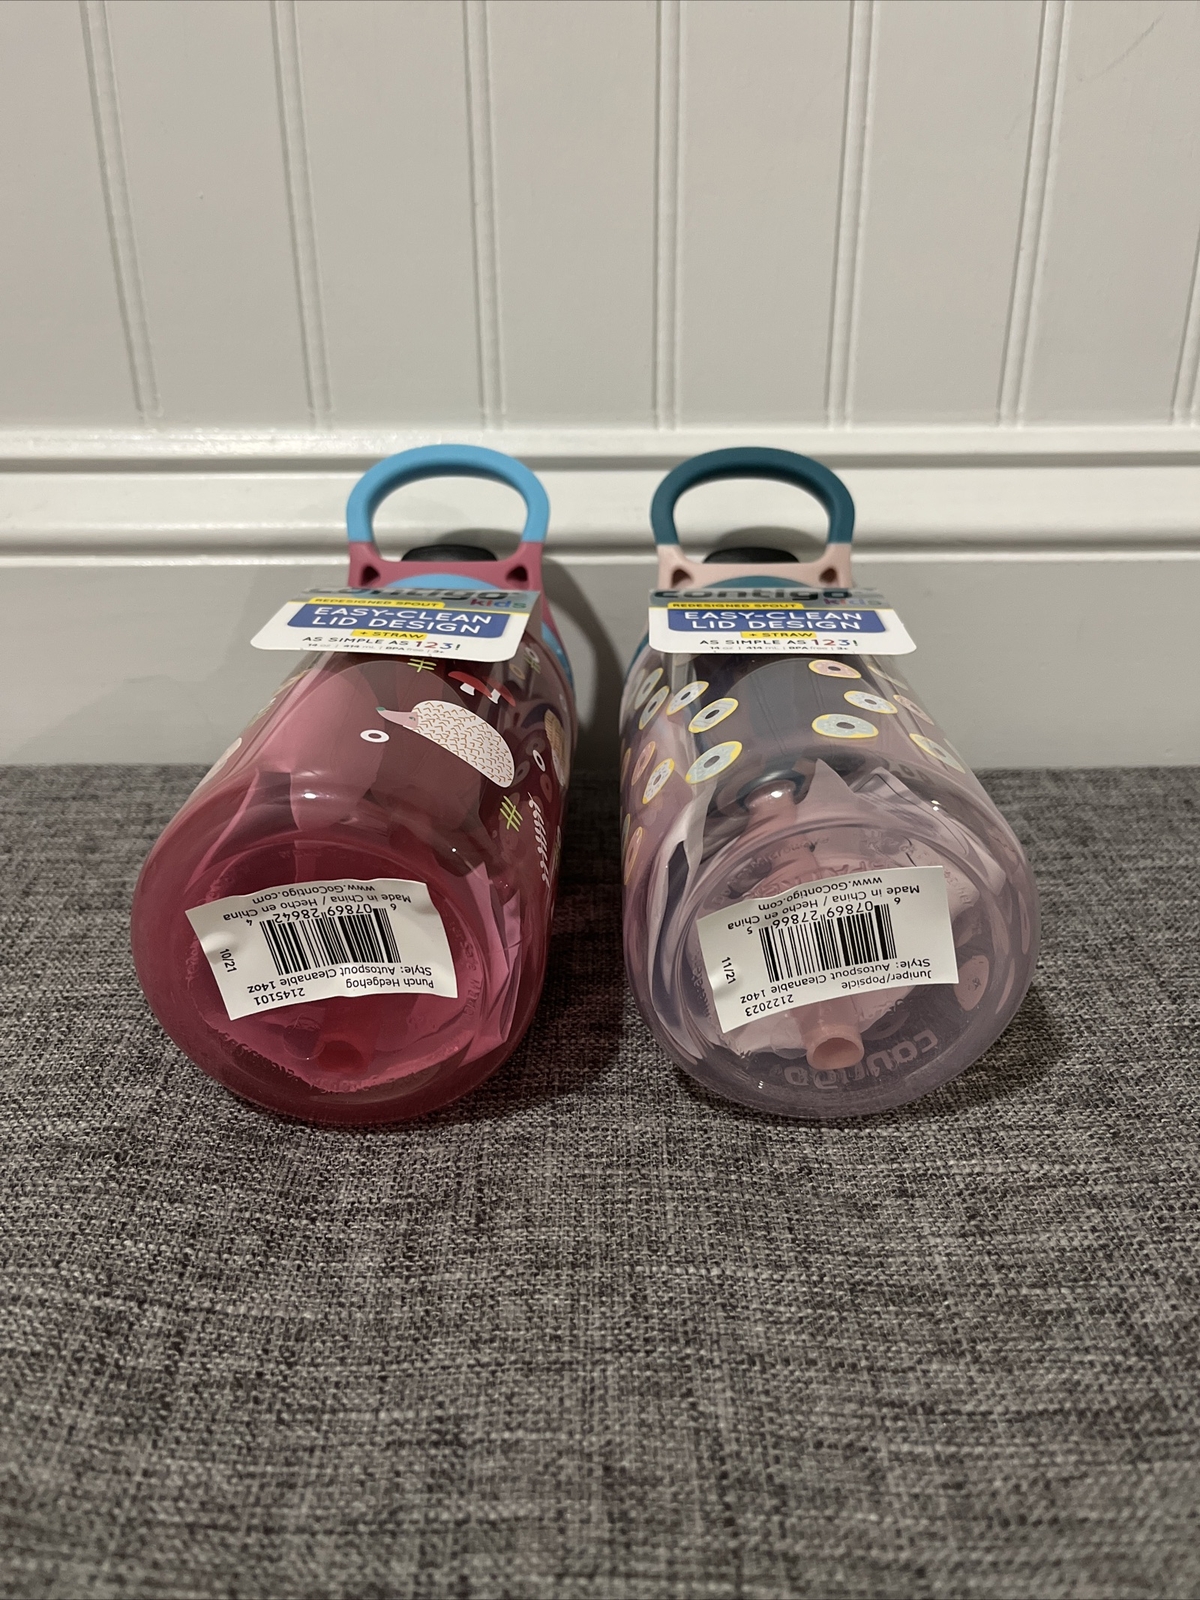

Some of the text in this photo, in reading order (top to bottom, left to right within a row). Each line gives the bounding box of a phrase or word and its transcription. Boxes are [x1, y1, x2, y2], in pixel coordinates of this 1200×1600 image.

[314, 597, 392, 605] REDESIGNED
[470, 598, 527, 609] kids
[314, 606, 492, 625] EASY-CLEAN
[684, 611, 862, 621] EASY-CLEAN
[312, 616, 481, 635] LID DESIGN
[691, 620, 861, 631] LID DESIGN
[328, 637, 384, 645] SIMPLE
[372, 630, 424, 639] STRAW
[252, 884, 376, 905] www.GoContigo.com
[757, 876, 883, 912] www.GoContigo.com
[871, 888, 883, 897] in
[886, 884, 920, 894] Made
[280, 898, 318, 909] Hecho
[331, 894, 364, 903] China
[380, 893, 412, 904] Made
[832, 891, 867, 903] China
[261, 903, 277, 913] en
[782, 899, 819, 914] Hecho
[222, 908, 259, 921] China
[245, 903, 397, 927] 6 07869 28642 4
[746, 896, 901, 935] 6 07869 27866 5
[764, 911, 779, 921] en
[727, 914, 761, 930] China
[219, 948, 238, 973] 10/21
[721, 956, 737, 985] 11/21
[246, 964, 433, 994] Style: Autospout Cleanable 14oz
[345, 977, 435, 989] Punch Hedgehog
[740, 958, 931, 1004] Style: Autospout Cleanable 14oz
[841, 969, 932, 989] Juniper/Popsicle
[253, 987, 306, 1006] 2145101
[744, 994, 794, 1017] 2122023
